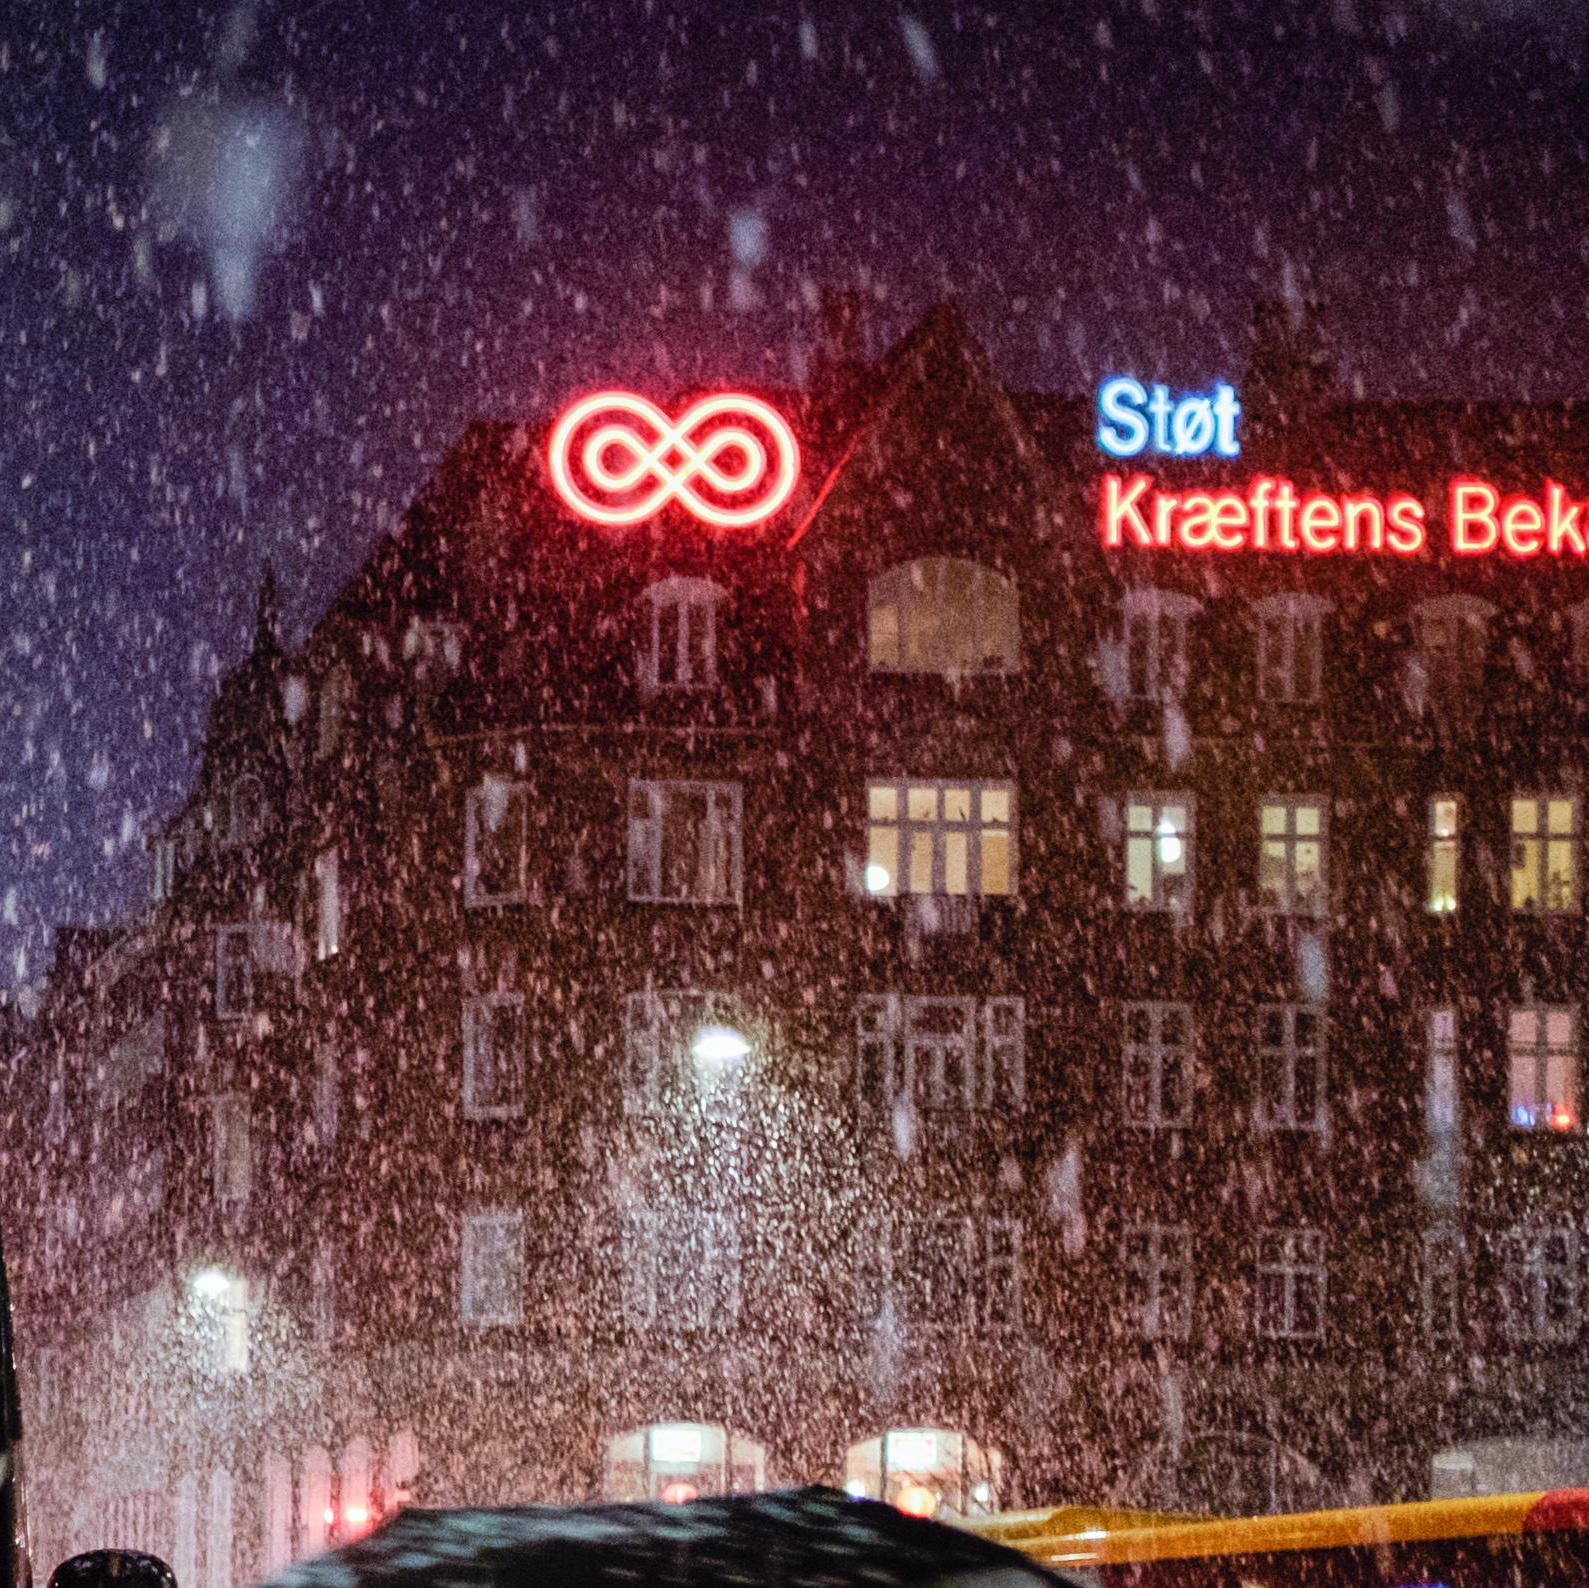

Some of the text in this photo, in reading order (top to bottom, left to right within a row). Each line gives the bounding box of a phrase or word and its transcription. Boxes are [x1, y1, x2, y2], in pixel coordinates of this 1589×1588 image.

[1099, 375, 1240, 458] Støt
[1103, 474, 1589, 555] Kræftens Bek
